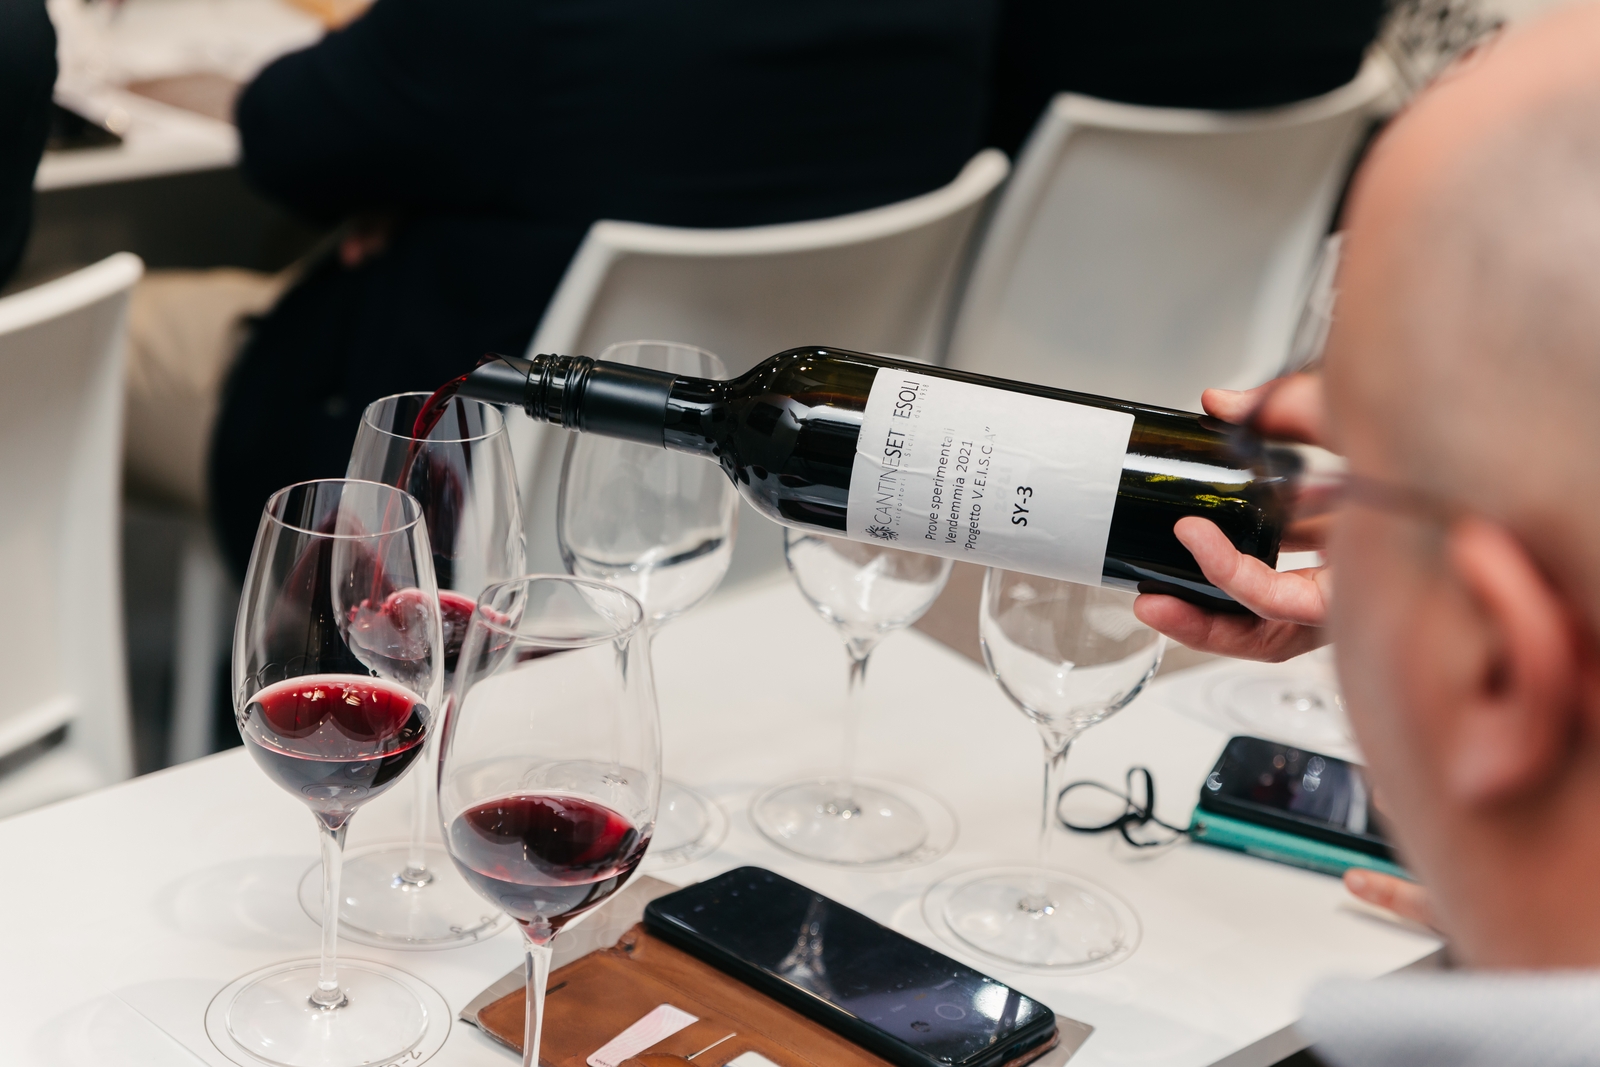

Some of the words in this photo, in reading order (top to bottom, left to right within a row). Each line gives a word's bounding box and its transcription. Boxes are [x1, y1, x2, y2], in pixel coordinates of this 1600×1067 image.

[931, 427, 955, 510] sperimentali
[945, 477, 965, 544] Vendemmia
[956, 440, 973, 473] 2021
[925, 512, 939, 541] Prove
[1011, 485, 1034, 527] SY-3
